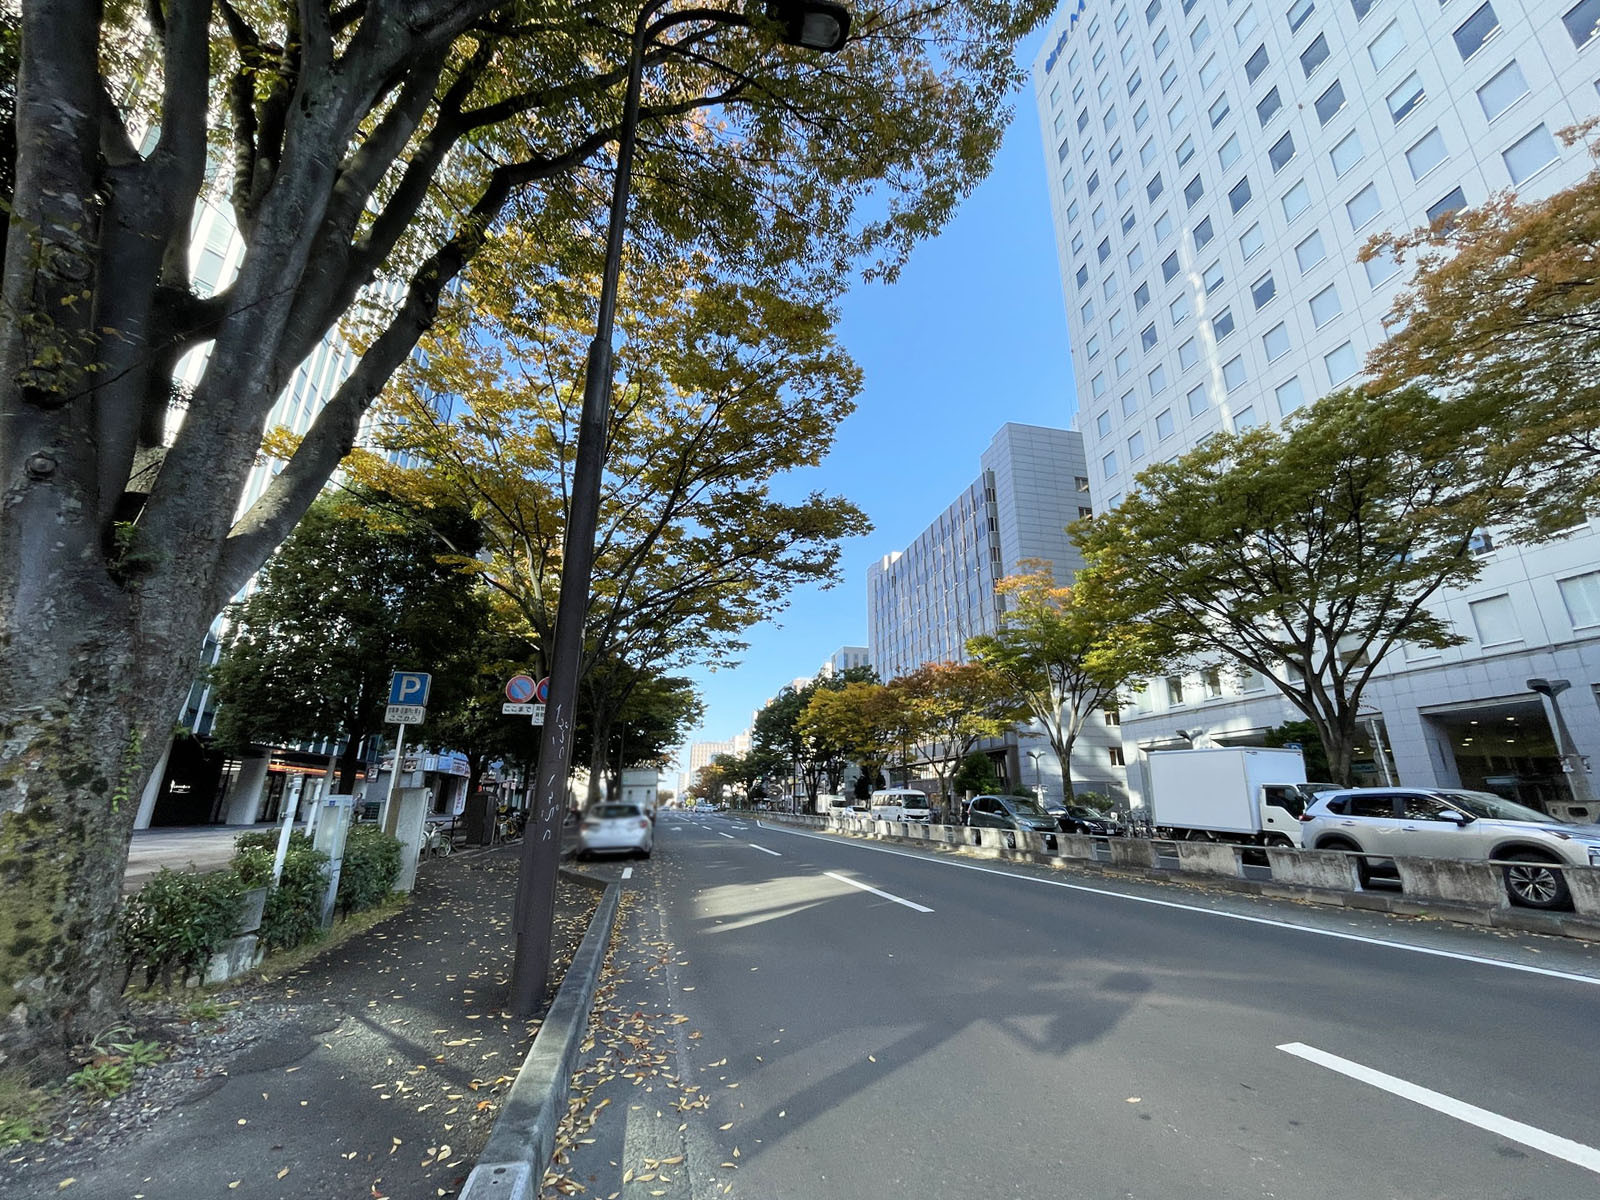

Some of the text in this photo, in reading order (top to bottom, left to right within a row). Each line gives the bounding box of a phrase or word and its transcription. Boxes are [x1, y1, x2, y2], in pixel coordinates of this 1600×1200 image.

[399, 676, 421, 701] P
[504, 705, 532, 713] ここまで
